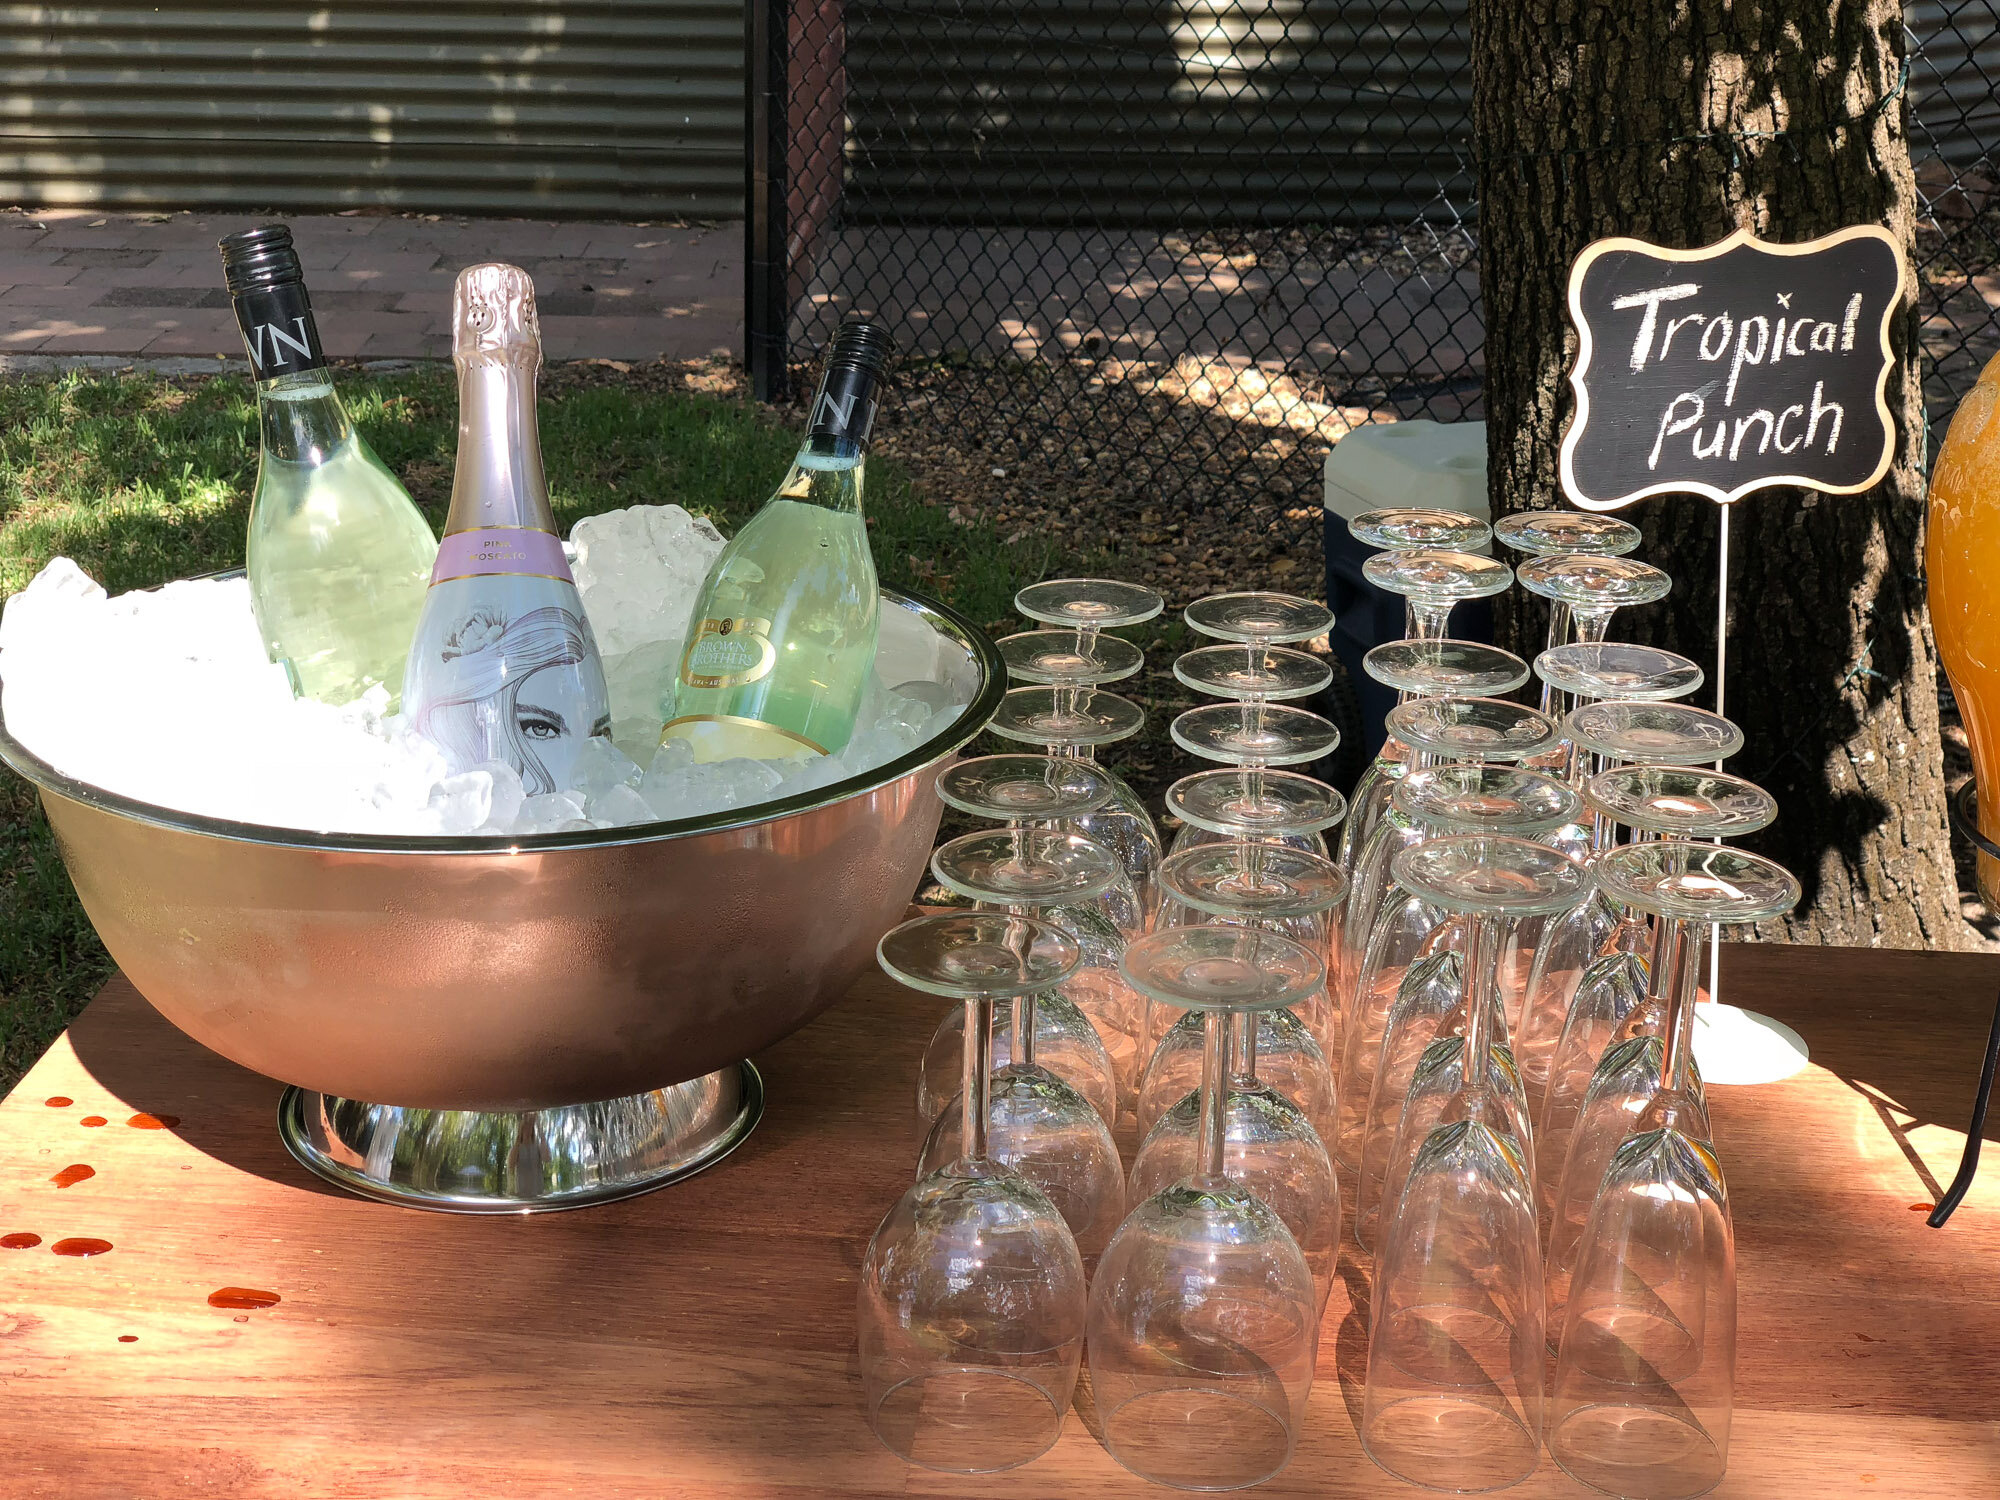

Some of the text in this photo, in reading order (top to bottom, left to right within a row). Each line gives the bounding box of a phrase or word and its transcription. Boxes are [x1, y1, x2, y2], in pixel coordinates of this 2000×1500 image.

[1611, 282, 1863, 408] Tropical
[1647, 379, 1844, 471] Punch
[699, 639, 748, 654] BROWN
